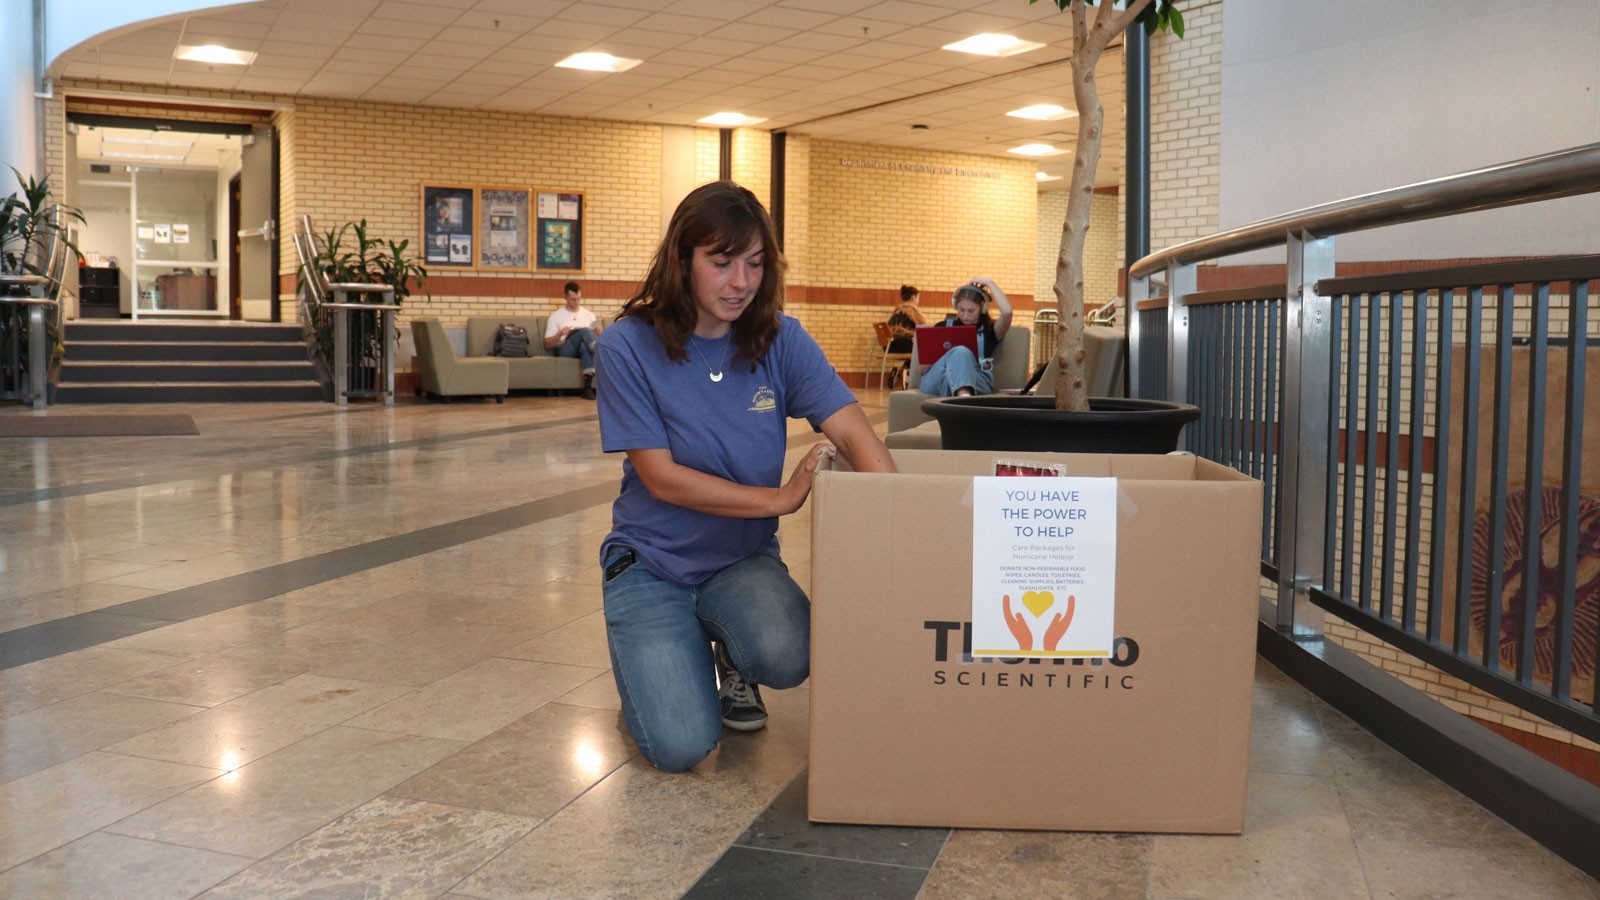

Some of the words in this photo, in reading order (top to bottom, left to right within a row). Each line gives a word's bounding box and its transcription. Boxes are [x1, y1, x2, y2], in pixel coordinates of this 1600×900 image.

[1006, 490, 1036, 501] YOU
[1040, 491, 1080, 502] HAVE
[1001, 508, 1029, 519] THE
[1034, 508, 1087, 520] POWER
[1014, 526, 1034, 537] TO
[1038, 526, 1074, 537] HELP
[1030, 544, 1064, 553] Packages
[933, 670, 1134, 690] SCIENTIFIC
